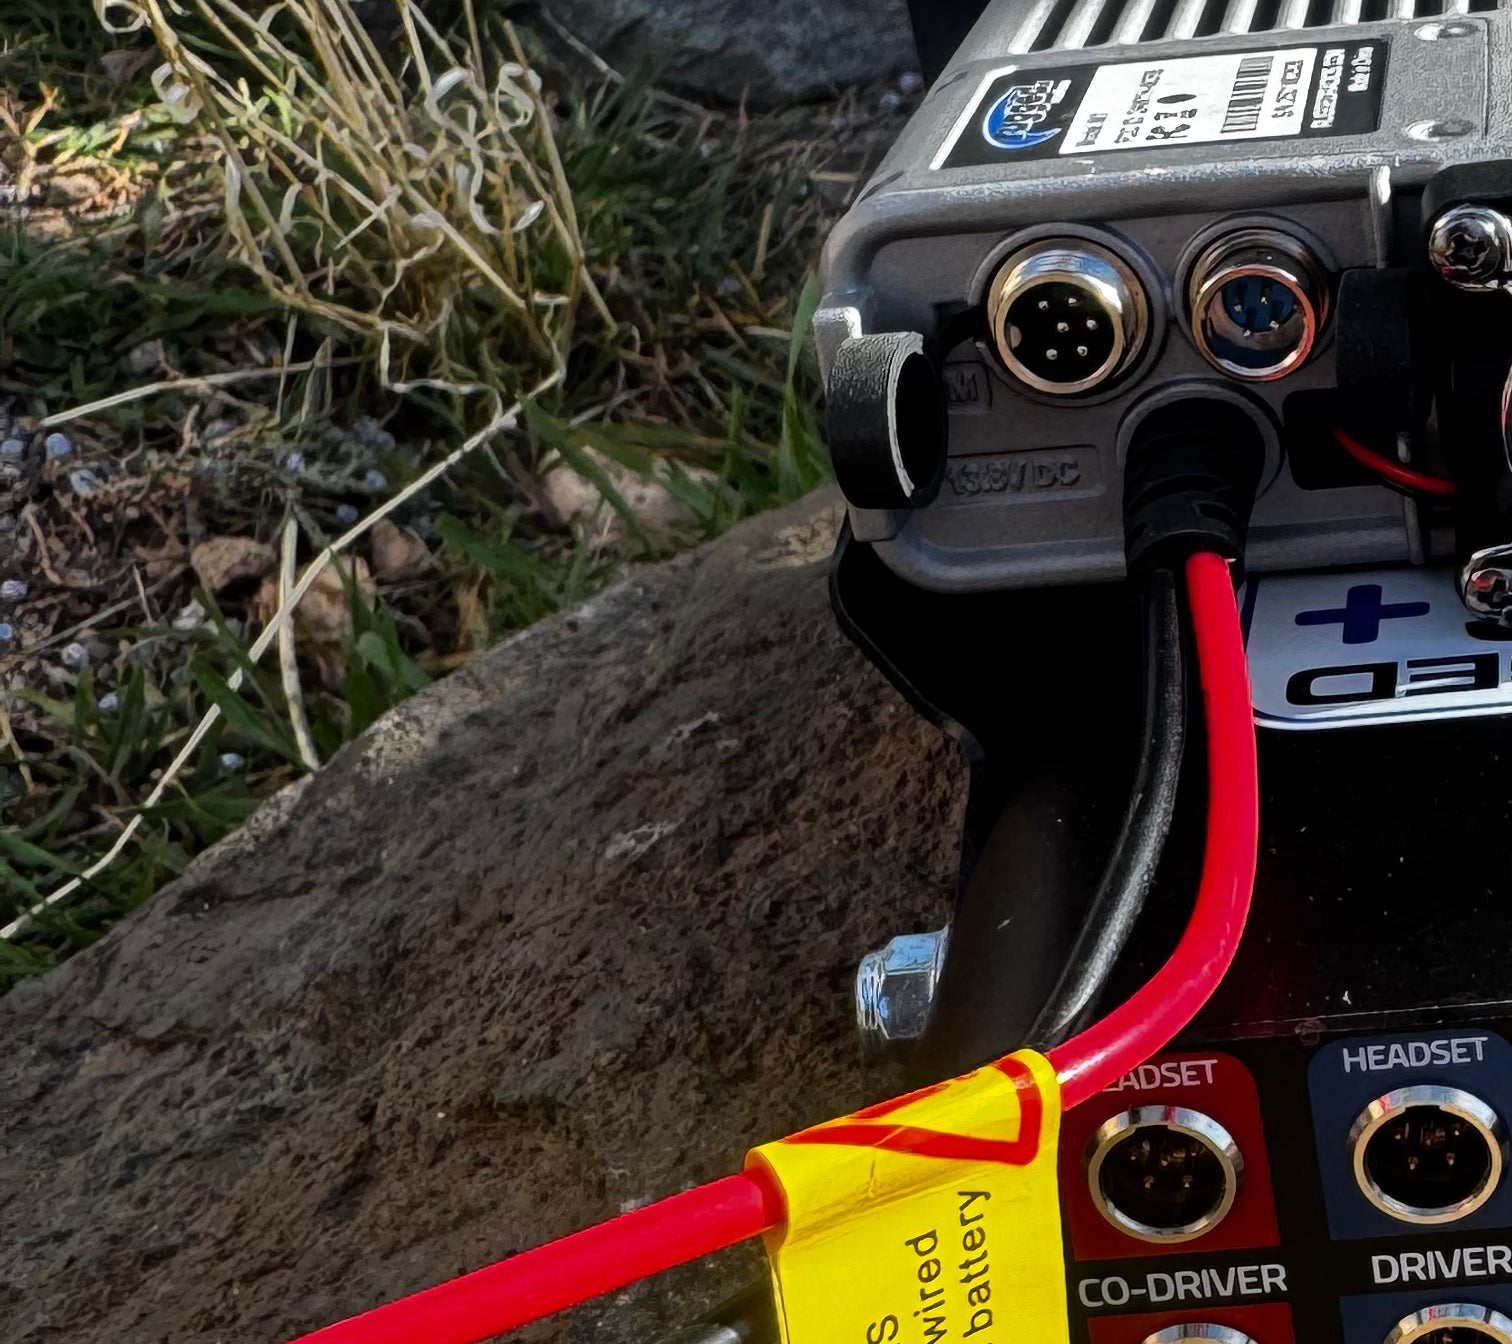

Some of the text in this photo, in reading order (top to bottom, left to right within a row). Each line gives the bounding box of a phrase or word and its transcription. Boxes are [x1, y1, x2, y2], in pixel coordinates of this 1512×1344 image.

[1342, 1036, 1489, 1074] HEADSET
[1101, 1059, 1219, 1093] ADSET
[957, 1190, 993, 1338] battery
[1371, 1245, 1512, 1284] DRIVER
[1078, 1263, 1288, 1308] CO-DRIVER
